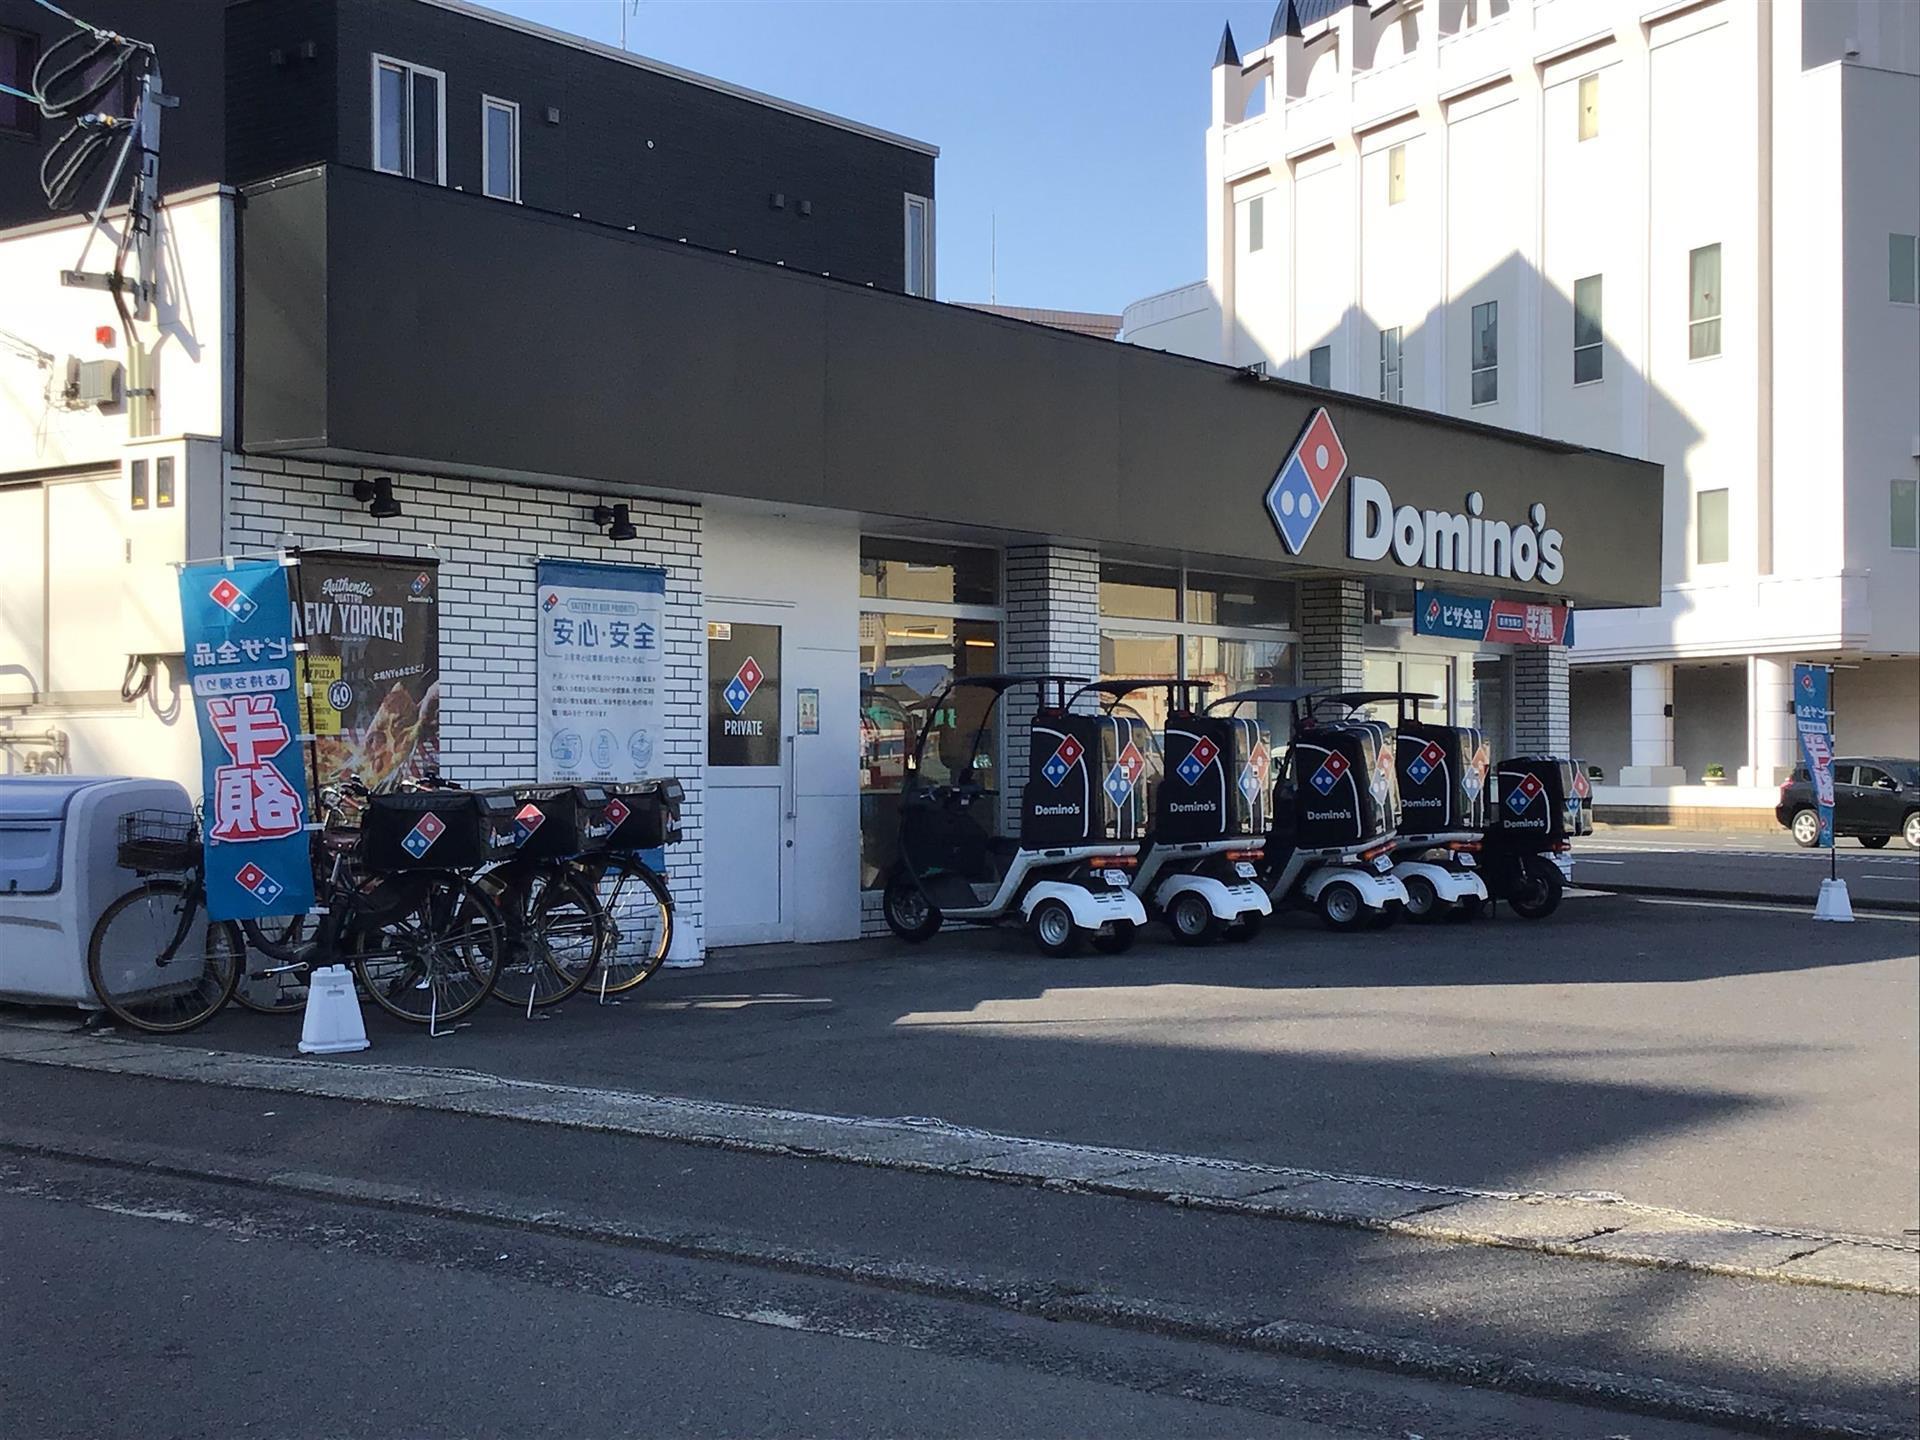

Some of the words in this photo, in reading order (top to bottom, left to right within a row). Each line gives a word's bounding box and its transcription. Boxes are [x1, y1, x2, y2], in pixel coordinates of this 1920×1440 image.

[1349, 475, 1564, 585] Domino's
[322, 577, 375, 597] Authentic
[334, 593, 363, 604] QUATTRO
[292, 601, 333, 638] NEW
[338, 603, 404, 643] YORKER
[1443, 606, 1484, 631] ピザ全品
[1526, 606, 1554, 640] 半額
[553, 618, 656, 650] 安心・安全
[314, 669, 336, 679] PIZZA
[332, 686, 349, 704] 40
[724, 720, 763, 736] PRIVATE
[1034, 803, 1080, 816] Domino's
[1170, 800, 1217, 813] Domino's
[1401, 797, 1442, 807] Domino's
[1307, 809, 1352, 820] Domino's
[1503, 817, 1545, 829] Domino's
